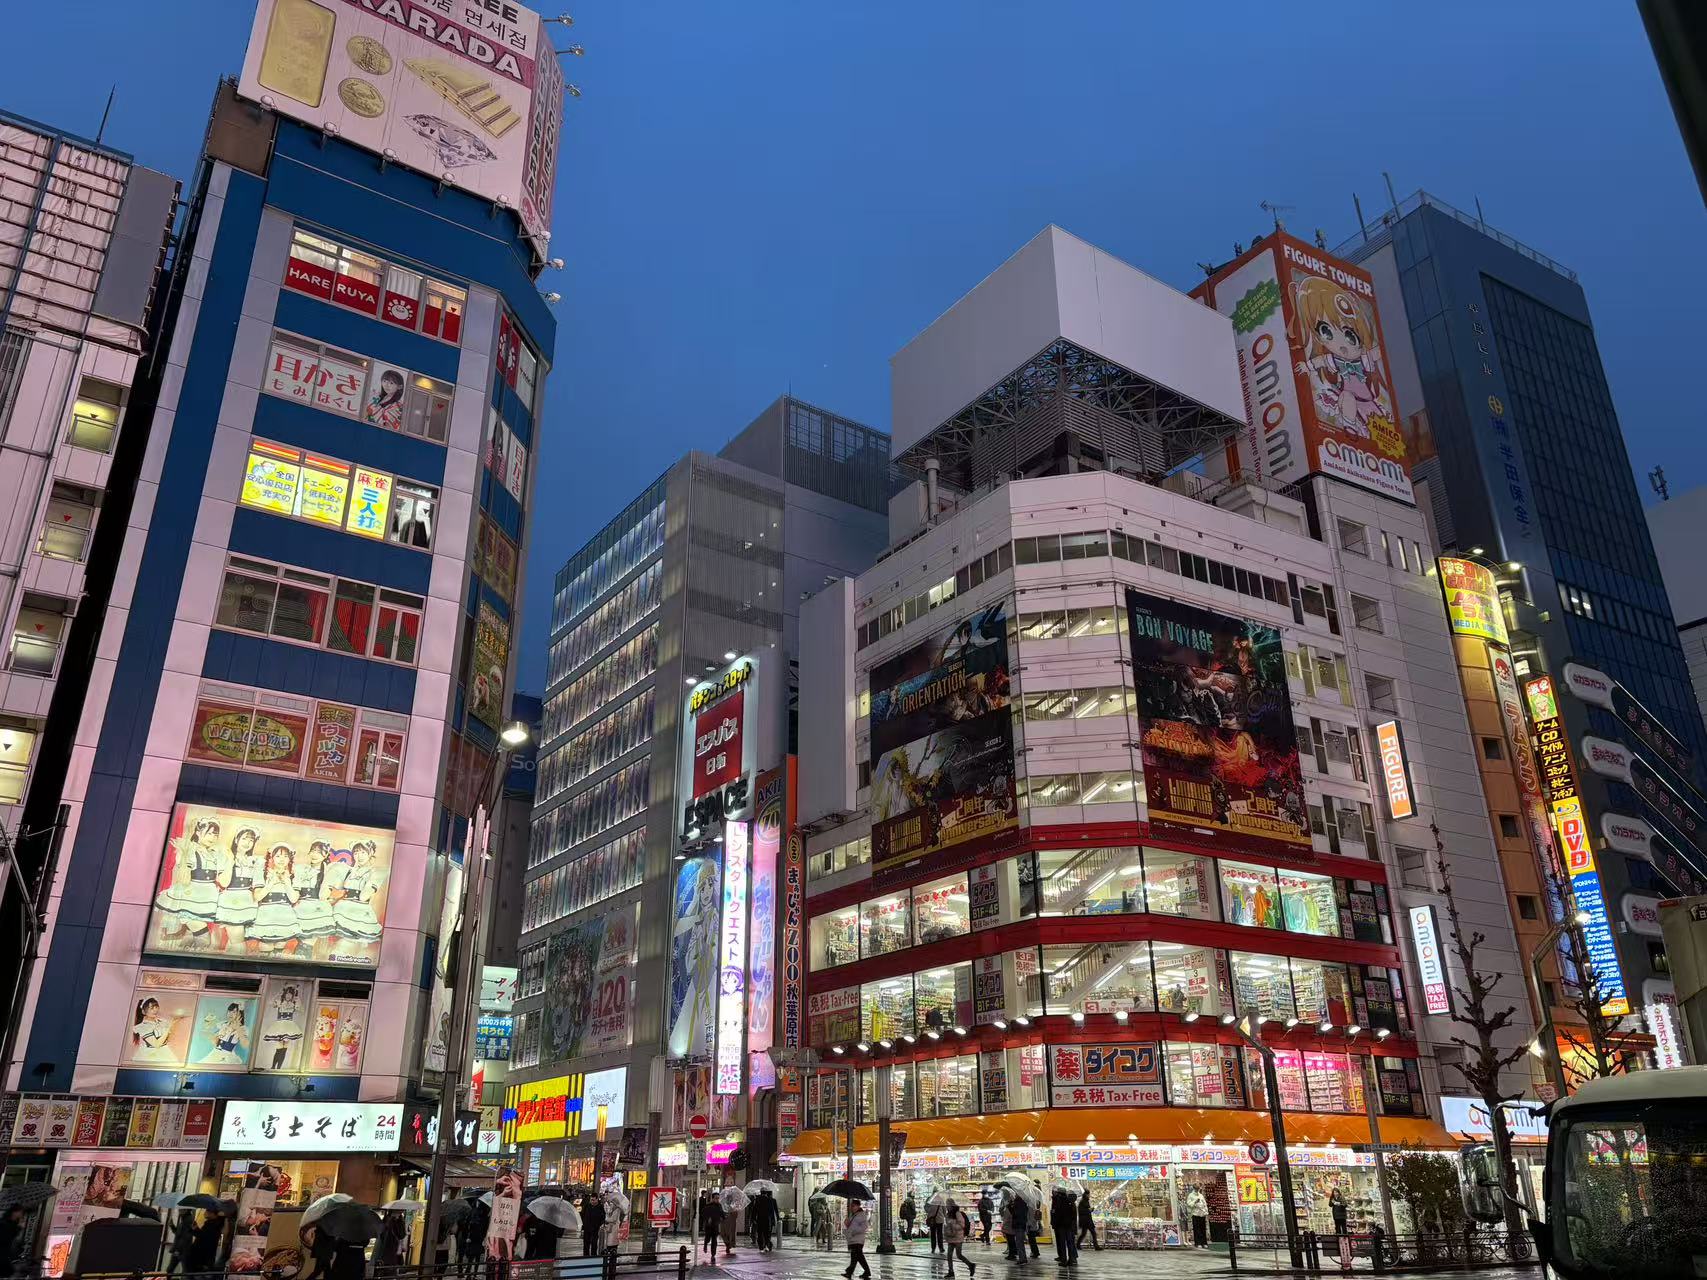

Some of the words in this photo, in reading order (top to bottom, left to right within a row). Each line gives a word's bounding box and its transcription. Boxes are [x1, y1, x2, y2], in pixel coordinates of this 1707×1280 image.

[465, 8, 527, 50] 면세점
[1283, 244, 1328, 277] FIGURE
[1328, 264, 1374, 297] TOWER
[289, 268, 331, 290] HARE
[336, 284, 376, 305] RUYA
[1252, 334, 1294, 477] amiami
[1323, 438, 1404, 483] amiami
[358, 472, 388, 489] 麻雀
[358, 488, 380, 529] 三人打
[1136, 614, 1162, 639] BON
[1166, 620, 1214, 655] VOYAGE
[902, 668, 967, 714] ORIENTATION
[696, 716, 738, 757] エスパス
[1537, 718, 1558, 732] ゲーム
[1540, 731, 1558, 743] CD
[1541, 741, 1564, 755] アイドル
[1543, 752, 1567, 766] アニメ
[1381, 736, 1407, 804] FIGURE
[1547, 764, 1569, 777] コミック
[1551, 775, 1571, 789] ホビー
[1562, 819, 1590, 870] DVD
[1416, 910, 1439, 980] amiami
[810, 991, 830, 1010] 免税
[830, 988, 859, 1006] Tax-Free
[1428, 994, 1445, 1002] TAX
[1429, 1001, 1447, 1010] FREE
[1056, 1047, 1082, 1082] 薬
[1085, 1047, 1156, 1075] ダイコク
[1072, 1087, 1106, 1104] 免税
[1106, 1089, 1161, 1102] Tax-Free
[517, 1095, 568, 1127] ラジオ会館
[261, 1114, 363, 1139] 富士そば
[376, 1114, 396, 1127] 24
[374, 1130, 395, 1141] 時間
[1139, 1150, 1158, 1161] 免税
[1069, 1168, 1087, 1178] B1F
[1088, 1168, 1116, 1178] お土産
